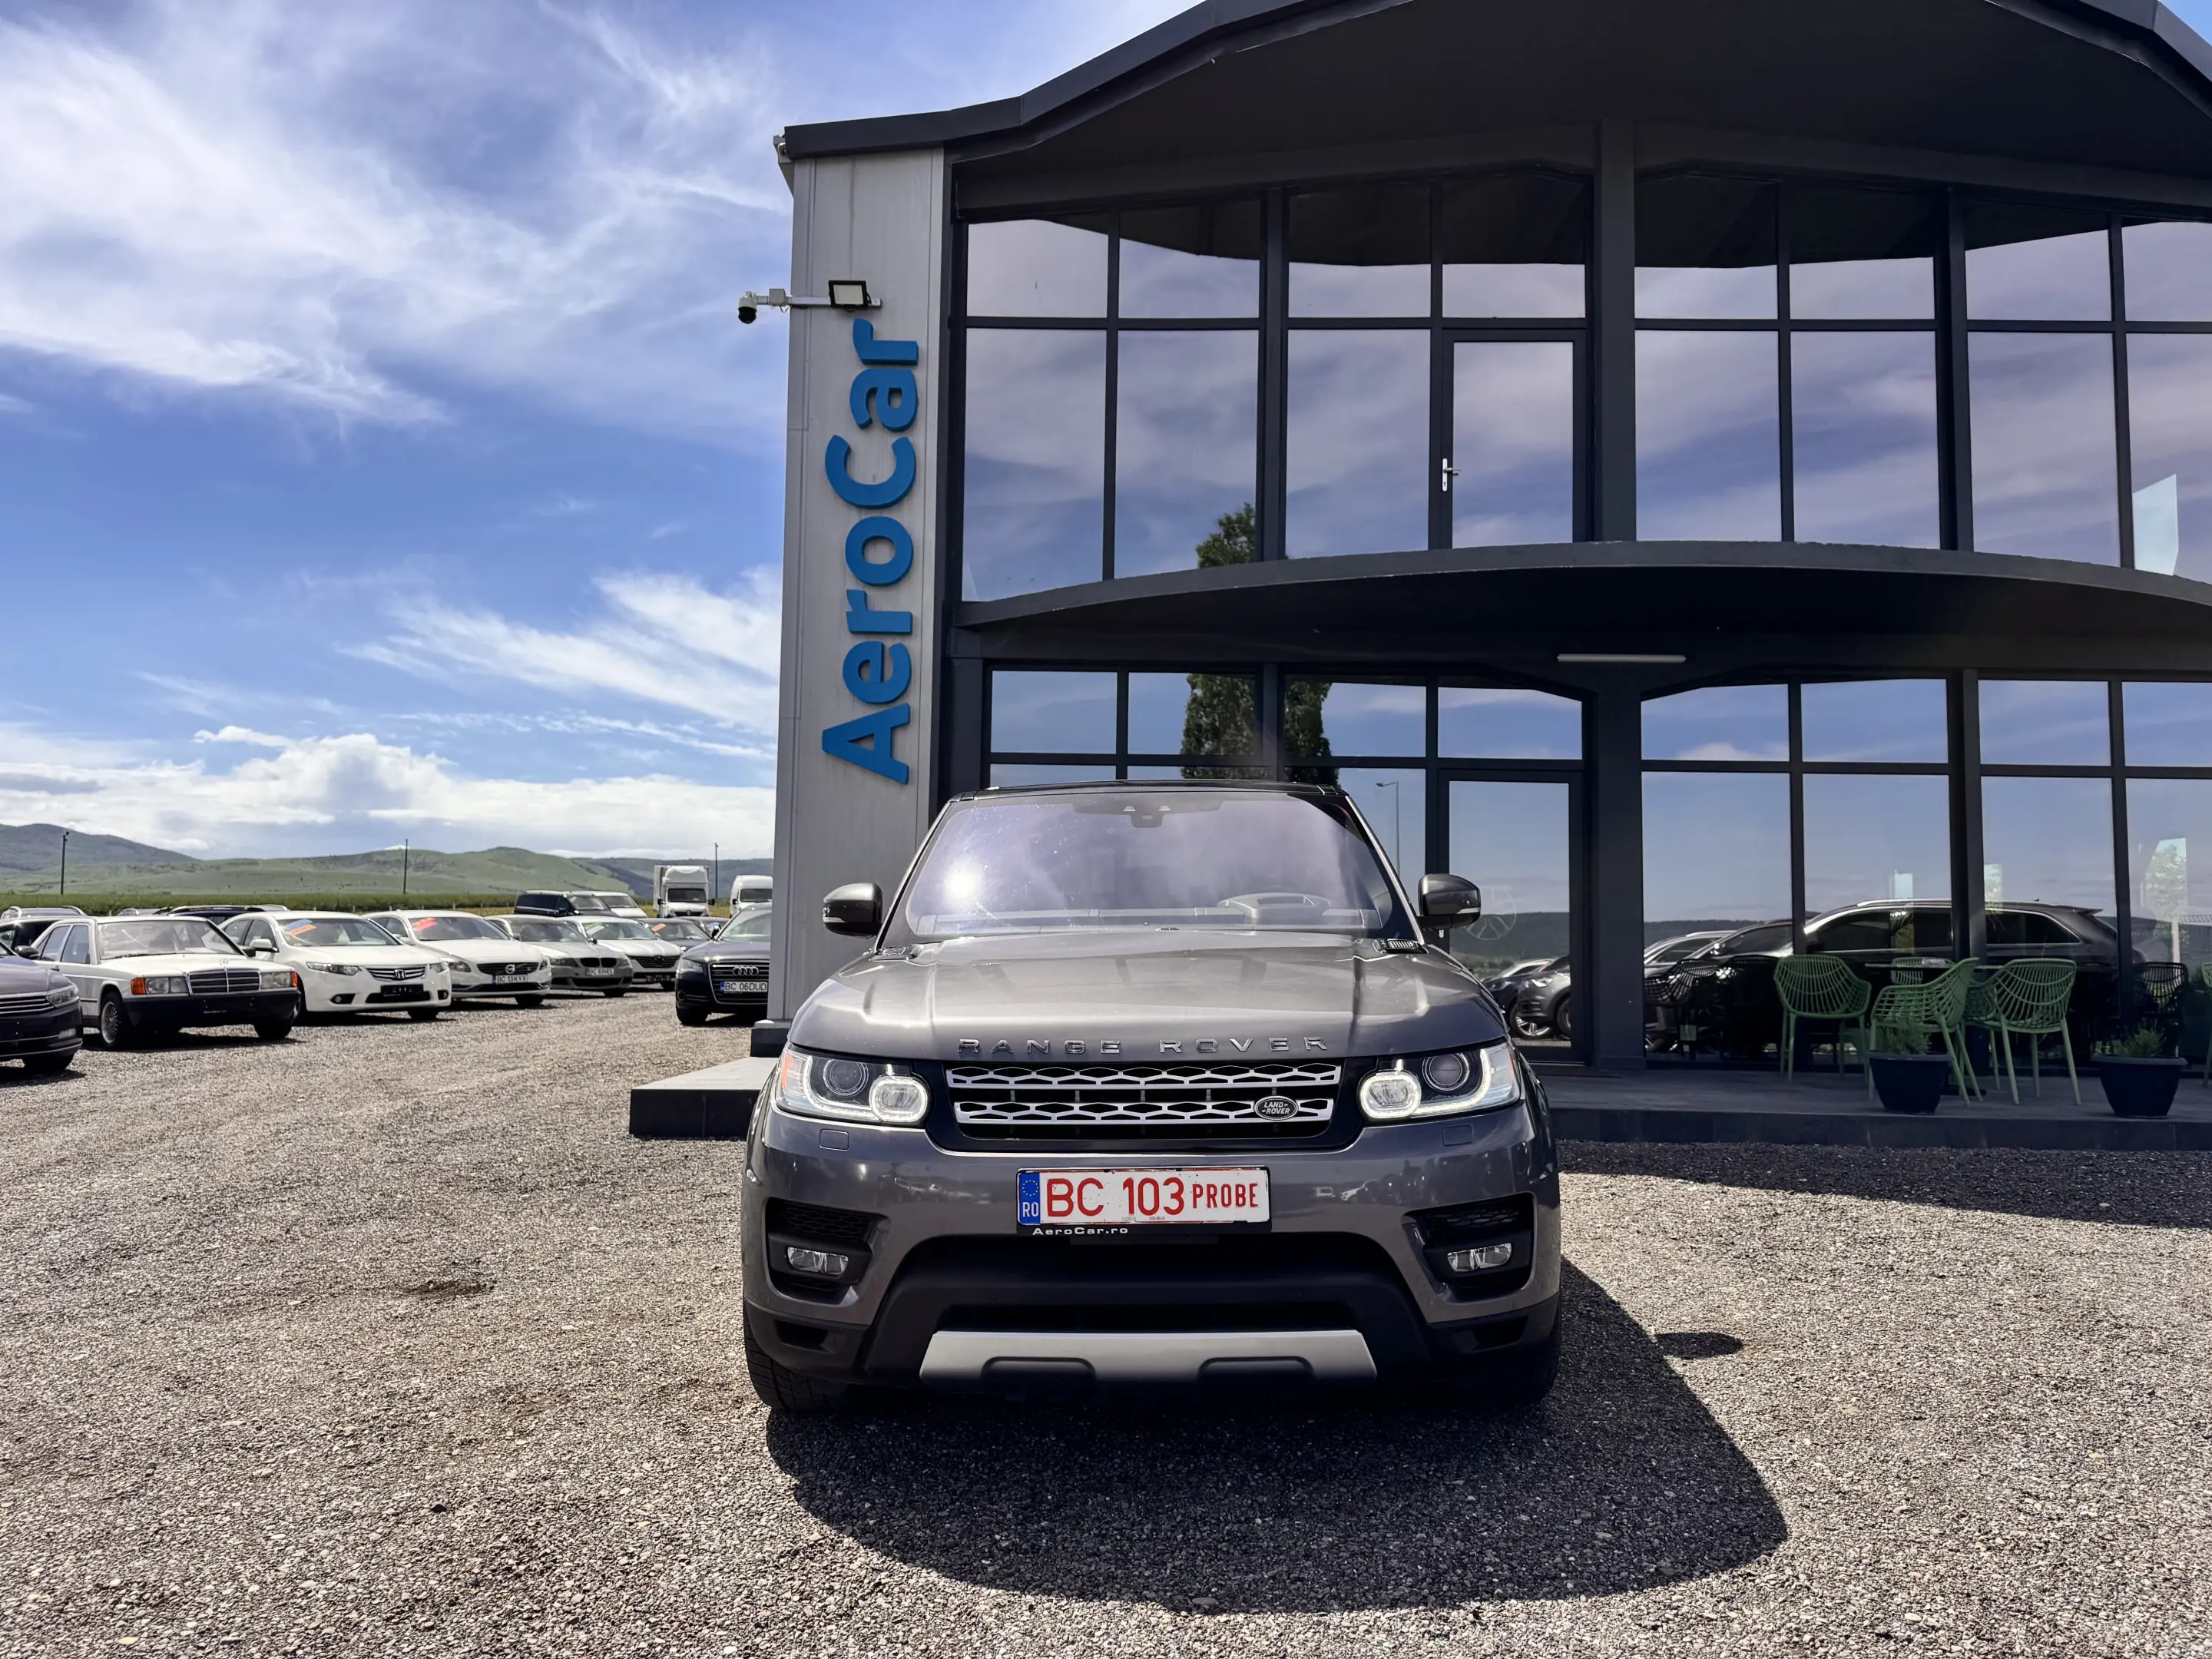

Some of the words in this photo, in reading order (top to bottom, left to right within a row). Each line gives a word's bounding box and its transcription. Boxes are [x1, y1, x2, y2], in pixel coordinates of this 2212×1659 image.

[822, 319, 918, 784] AeroCar
[739, 982, 767, 991] 06DUD
[957, 1038, 1120, 1055] RANGE
[1159, 1037, 1328, 1054] ROVER
[1047, 1178, 1104, 1217] BC
[1123, 1177, 1184, 1216] 103
[1193, 1183, 1258, 1208] PROBE
[1023, 1201, 1039, 1217] RO
[1032, 1227, 1128, 1235] AeroCar.ro
